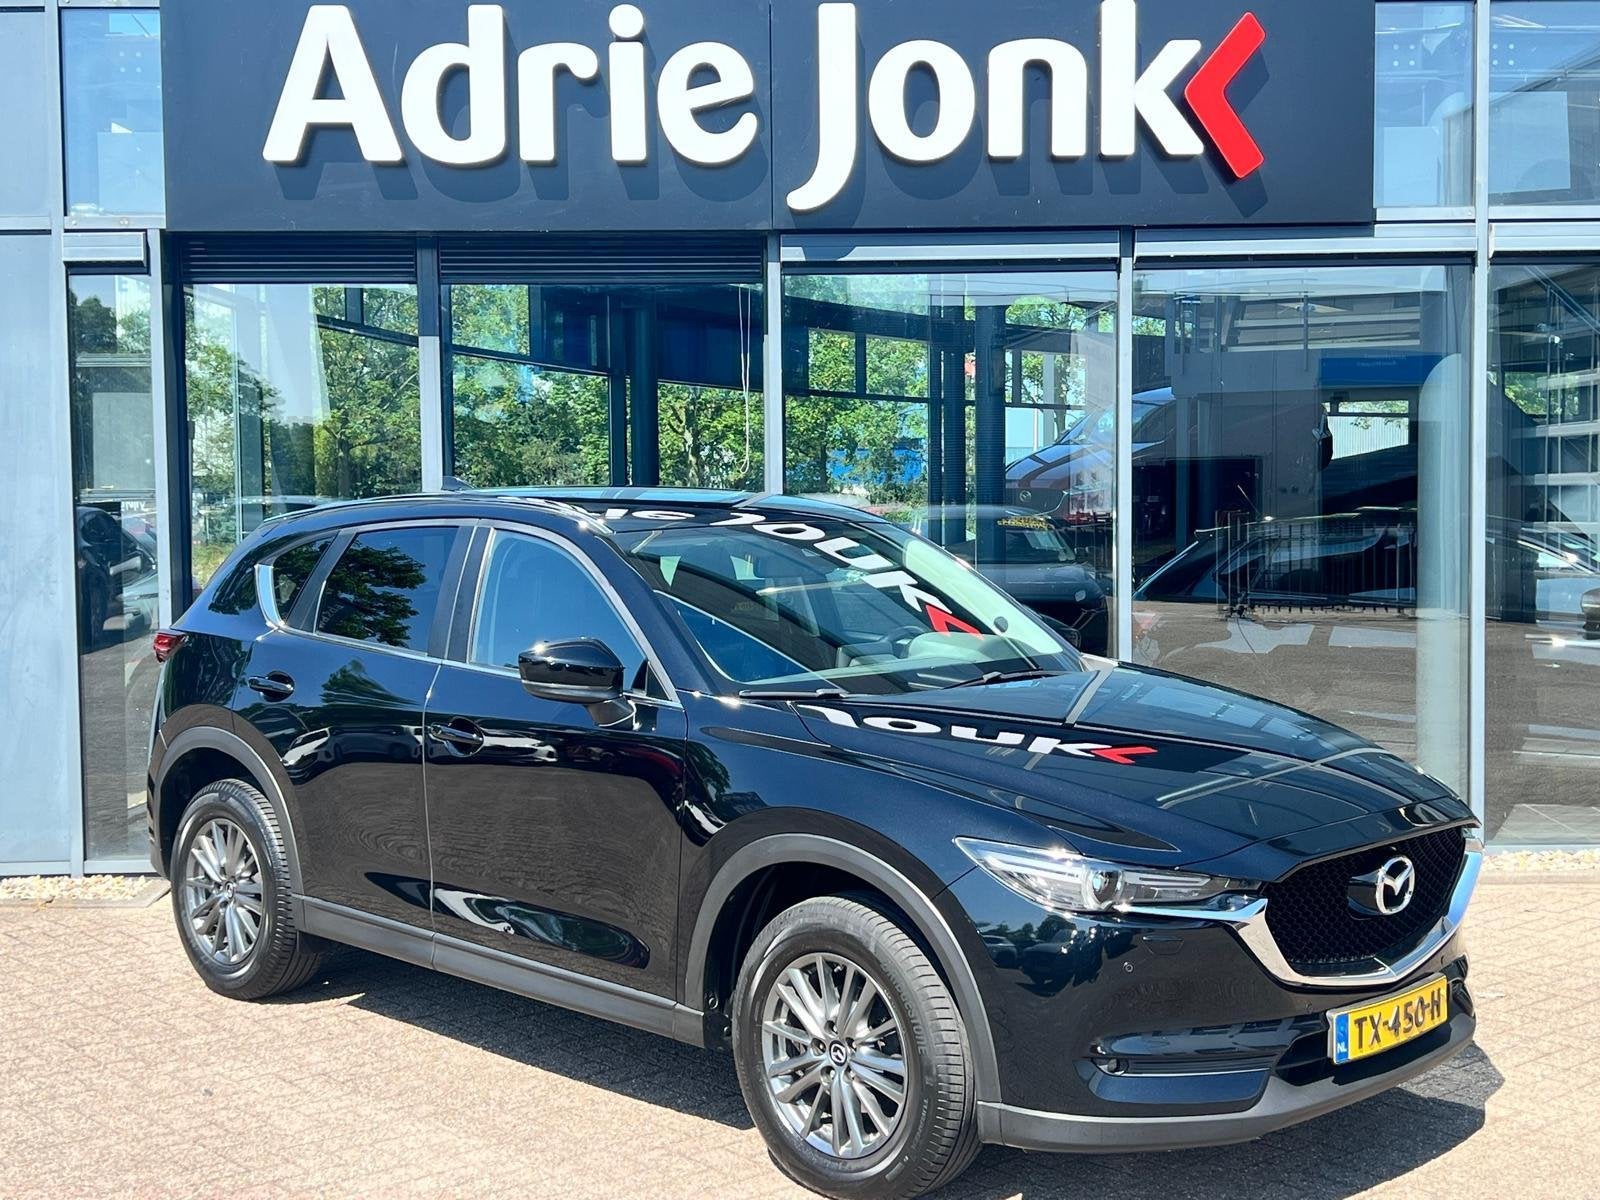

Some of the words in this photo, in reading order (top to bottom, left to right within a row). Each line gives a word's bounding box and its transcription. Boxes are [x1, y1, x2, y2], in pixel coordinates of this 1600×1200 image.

[263, 4, 758, 164] Adrie
[786, 0, 1204, 211] Jonk
[1337, 1042, 1347, 1053] NL
[1354, 987, 1441, 1049] TX-450-H
